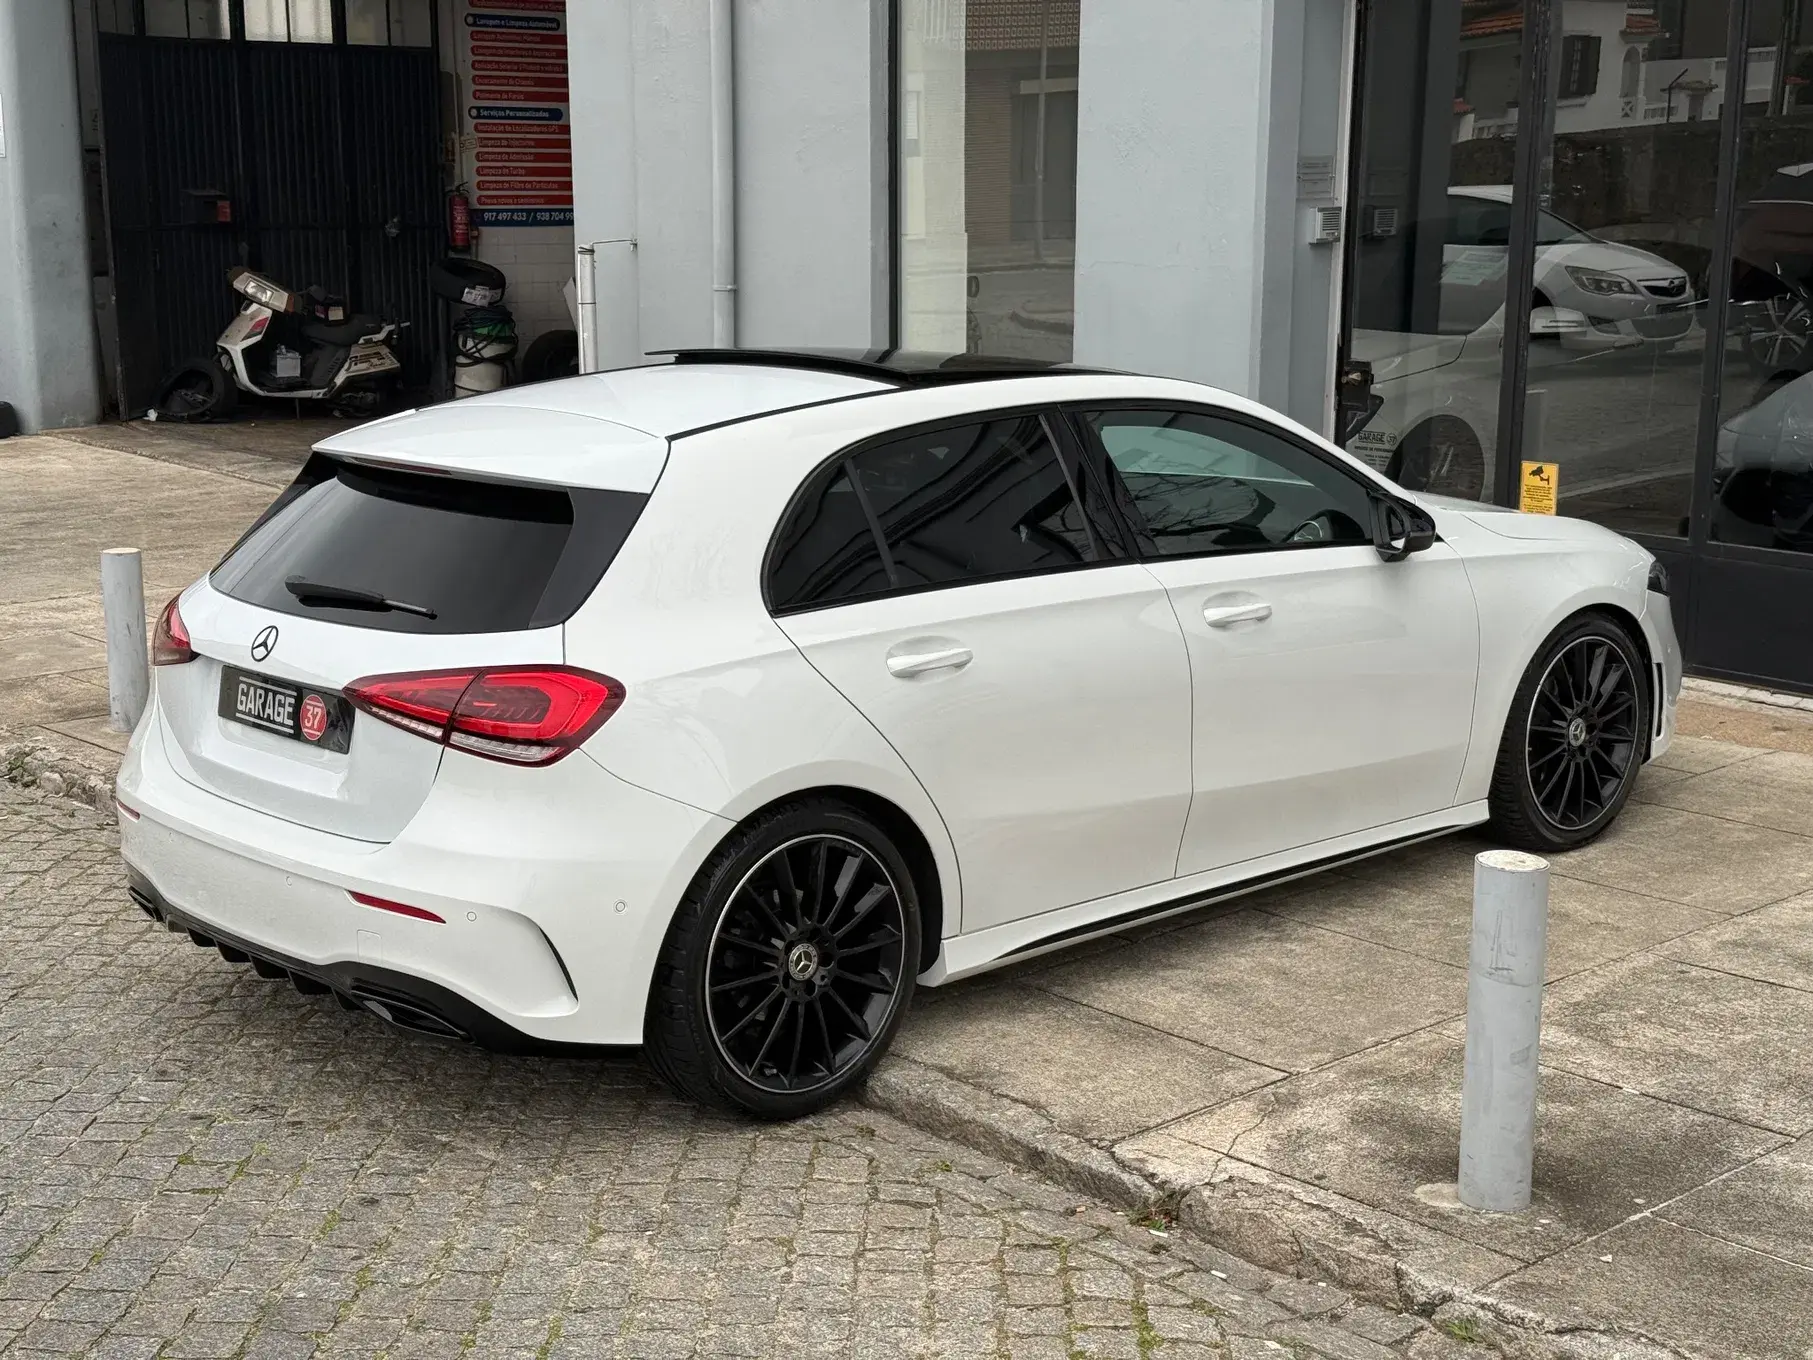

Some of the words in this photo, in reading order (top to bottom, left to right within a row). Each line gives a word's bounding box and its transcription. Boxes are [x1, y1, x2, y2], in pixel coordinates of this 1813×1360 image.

[480, 109, 505, 119] Serviços
[505, 109, 549, 118] Personalizados
[480, 167, 502, 175] Limpeza
[480, 181, 502, 190] Limpeza
[483, 212, 497, 220] 917
[497, 212, 511, 220] 497
[550, 212, 564, 220] 704
[236, 683, 296, 727] GARAGE
[304, 705, 322, 729] 37
